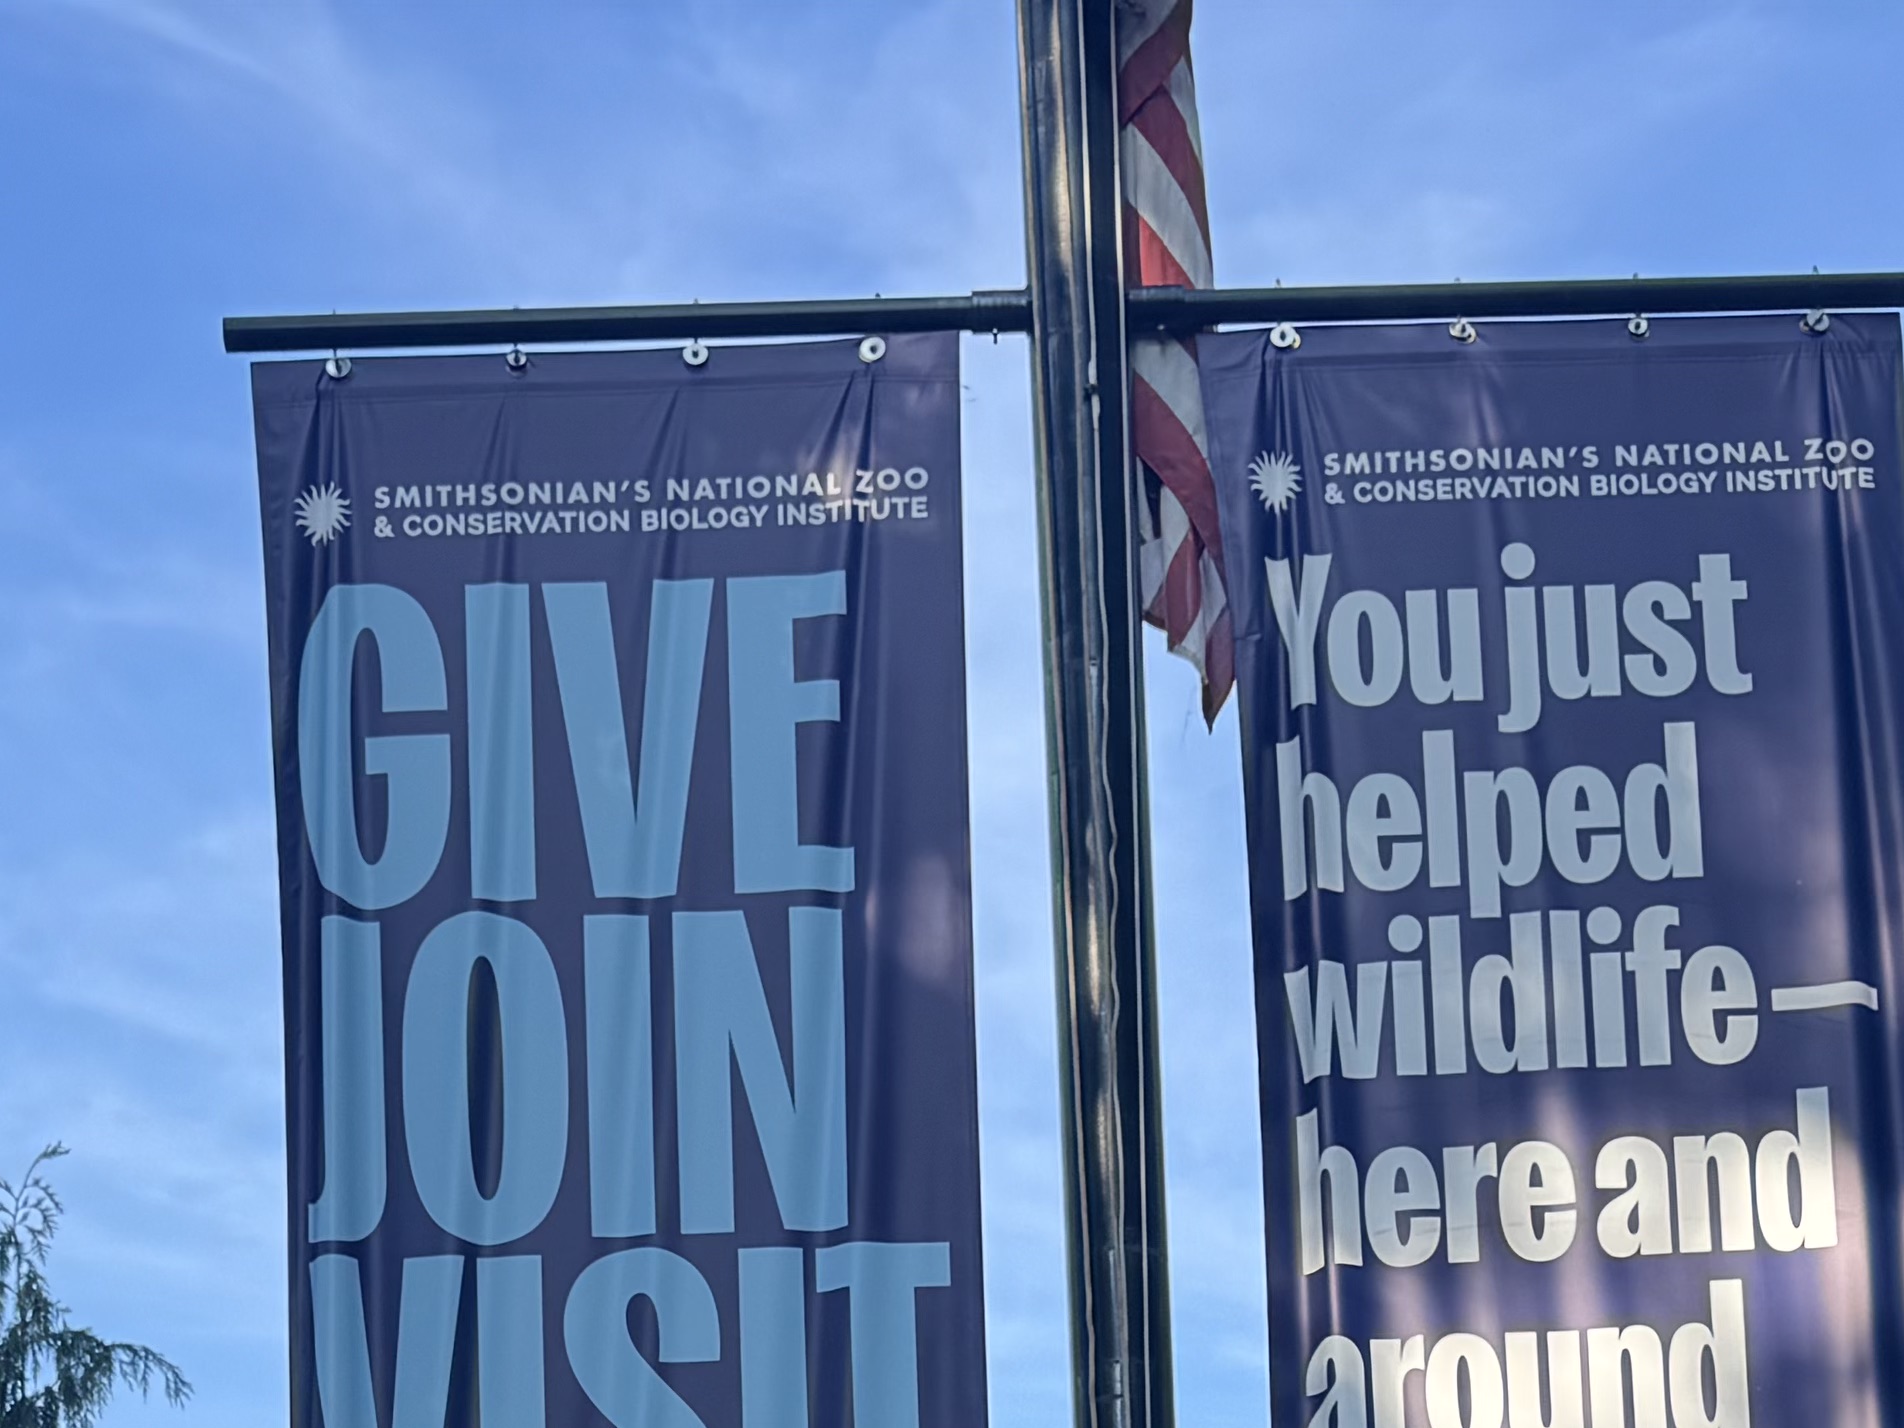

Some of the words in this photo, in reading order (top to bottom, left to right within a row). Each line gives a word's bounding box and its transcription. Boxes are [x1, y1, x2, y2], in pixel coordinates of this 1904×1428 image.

[374, 480, 651, 509] SMITHSONIAN'S
[667, 472, 841, 503] NATIONAL
[855, 467, 929, 493] ZOO
[374, 515, 395, 538] &
[403, 509, 631, 537] CONSERVATION
[641, 504, 769, 533] BIOLOGY
[777, 496, 929, 527] INSTITUTE
[1323, 445, 1599, 477] SMITHSONIAN'S
[1615, 440, 1789, 467] NATIONAL
[1804, 437, 1875, 463] ZOO
[1324, 481, 1346, 506] &
[1353, 476, 1580, 504] CONSERVATION
[1591, 470, 1714, 497] BIOLOGY
[1726, 466, 1875, 492] INSTITUTE
[1265, 553, 1484, 710] You
[1498, 542, 1753, 733] just
[297, 569, 856, 910] GIVE
[1276, 720, 1704, 919] helped
[308, 906, 849, 1246] JOIN
[1297, 1107, 1577, 1276] here
[1595, 1086, 1838, 1258] and
